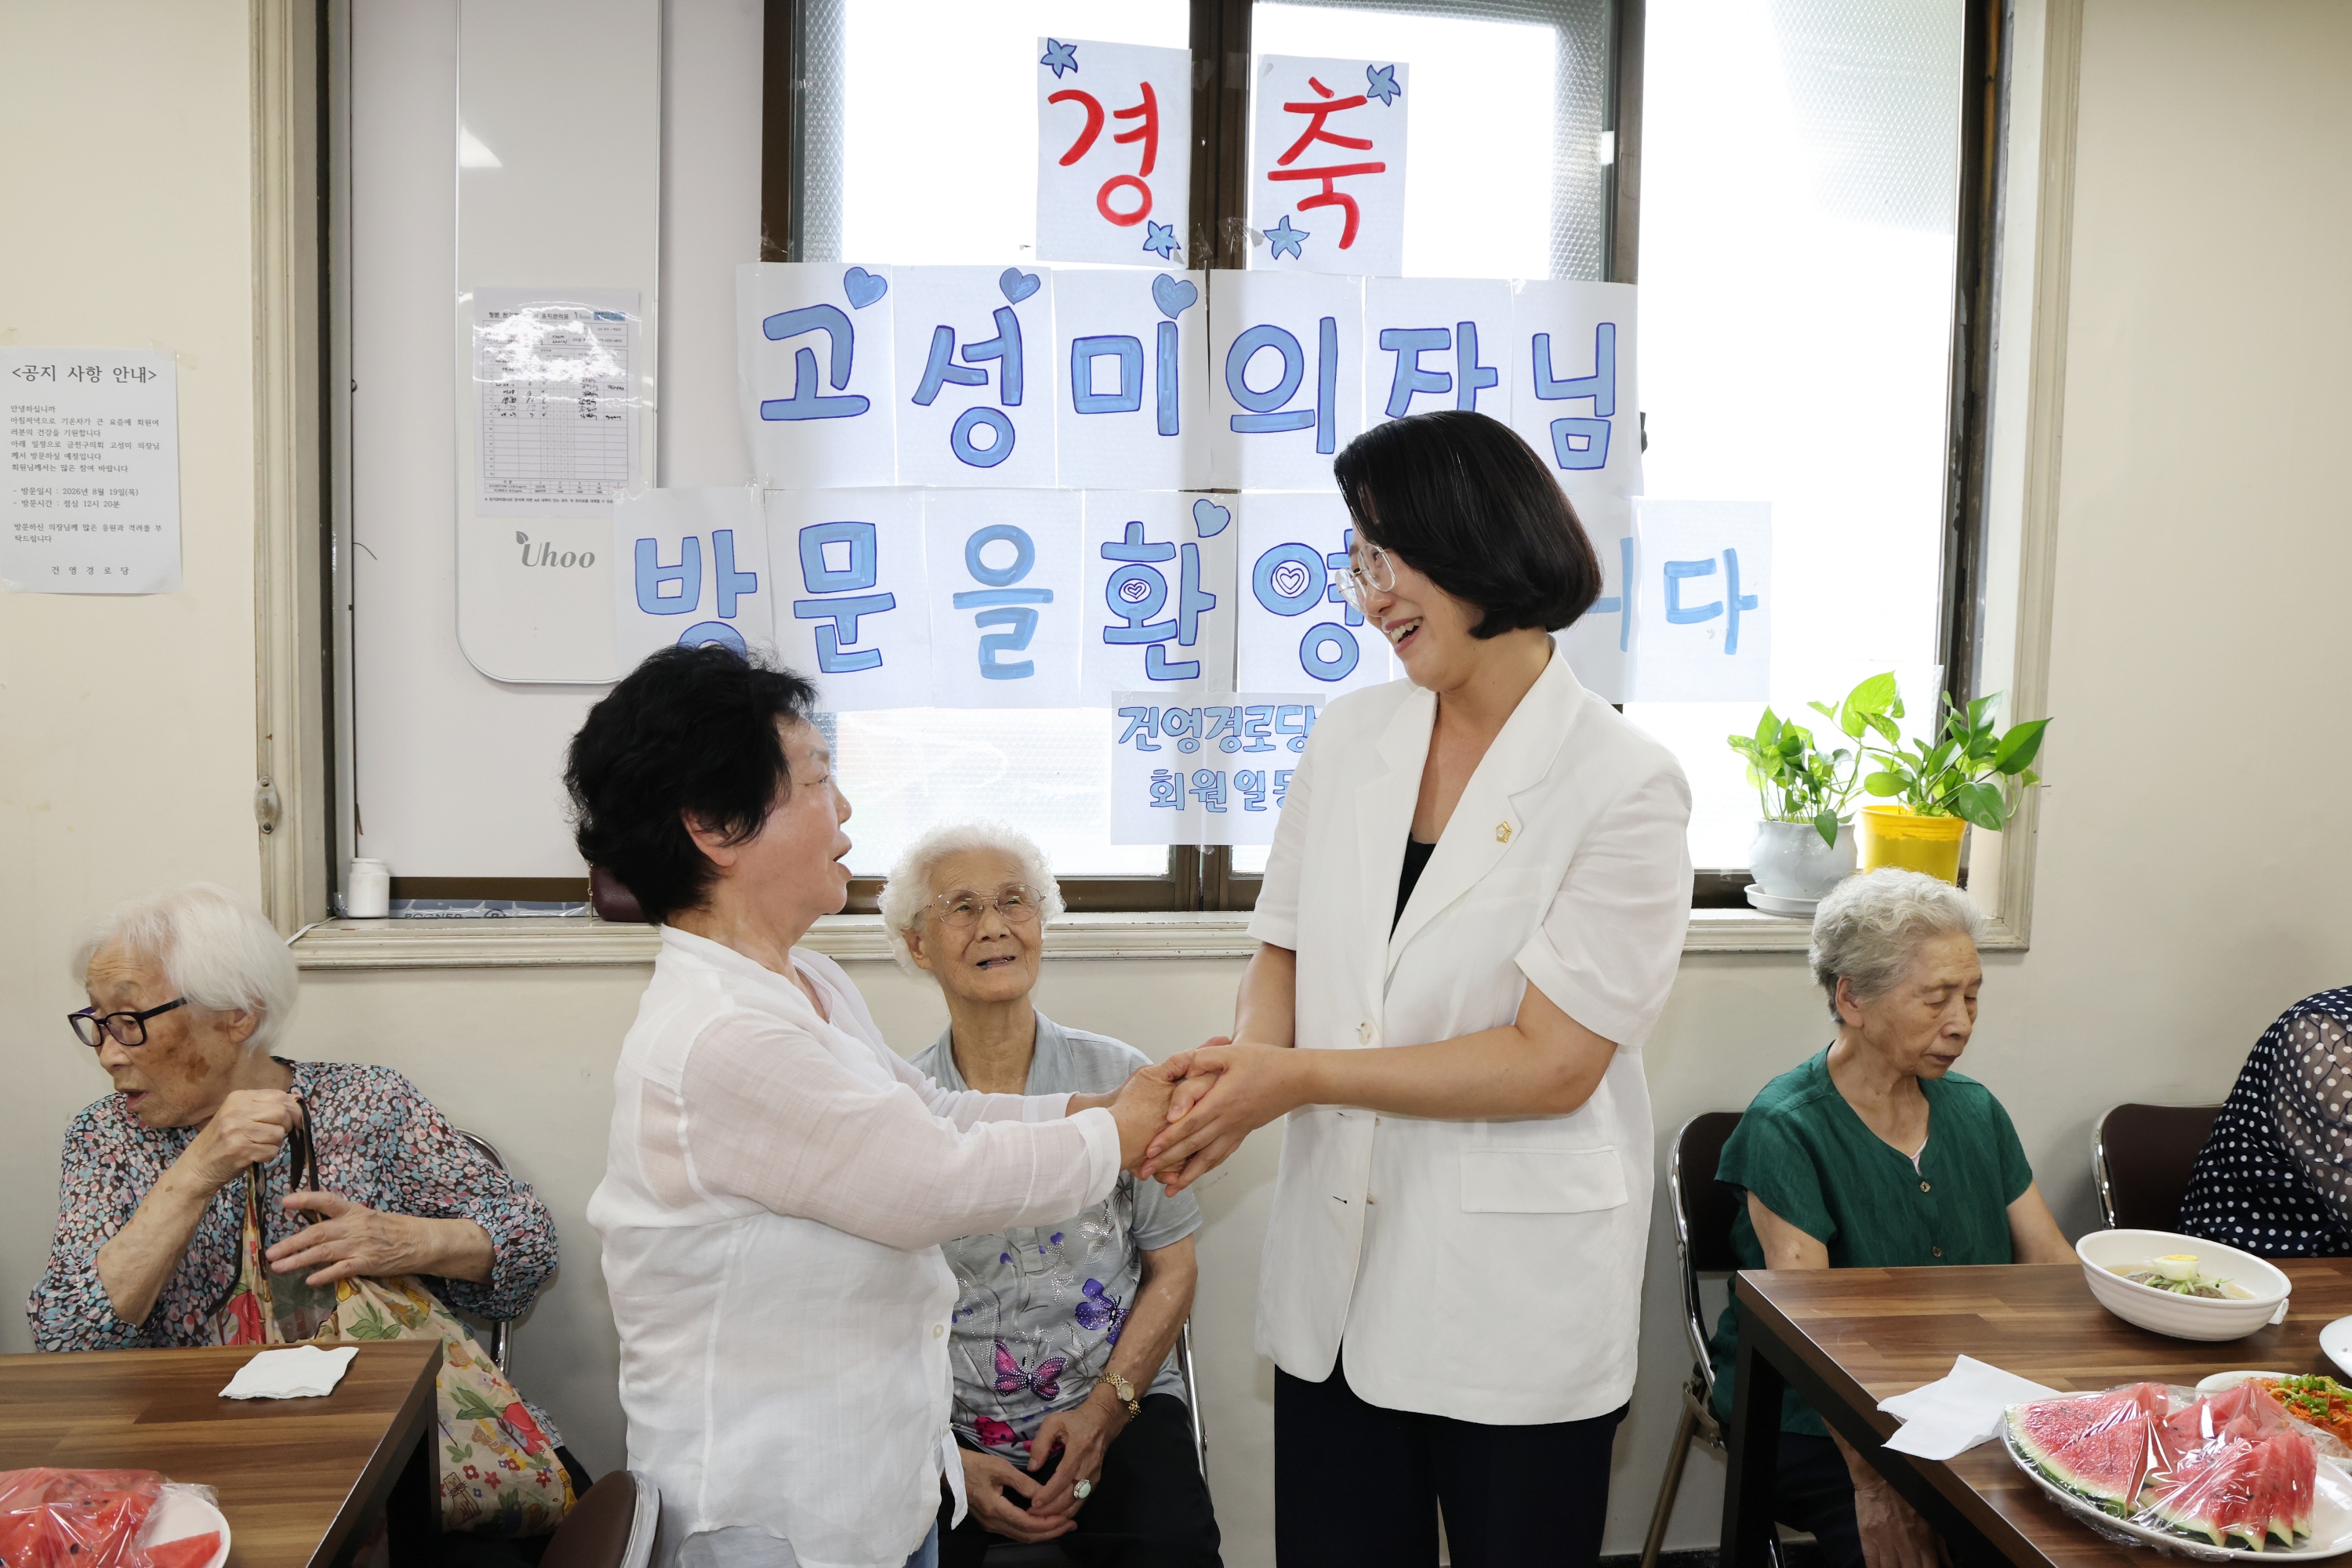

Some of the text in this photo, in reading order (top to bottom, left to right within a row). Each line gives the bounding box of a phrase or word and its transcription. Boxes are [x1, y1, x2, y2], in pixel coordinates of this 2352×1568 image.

[1047, 76, 1386, 250] 경 축
[12, 365, 157, 383] <공지 사항 안내>
[21, 487, 52, 495] 방문일시
[521, 542, 595, 568] Uhoo
